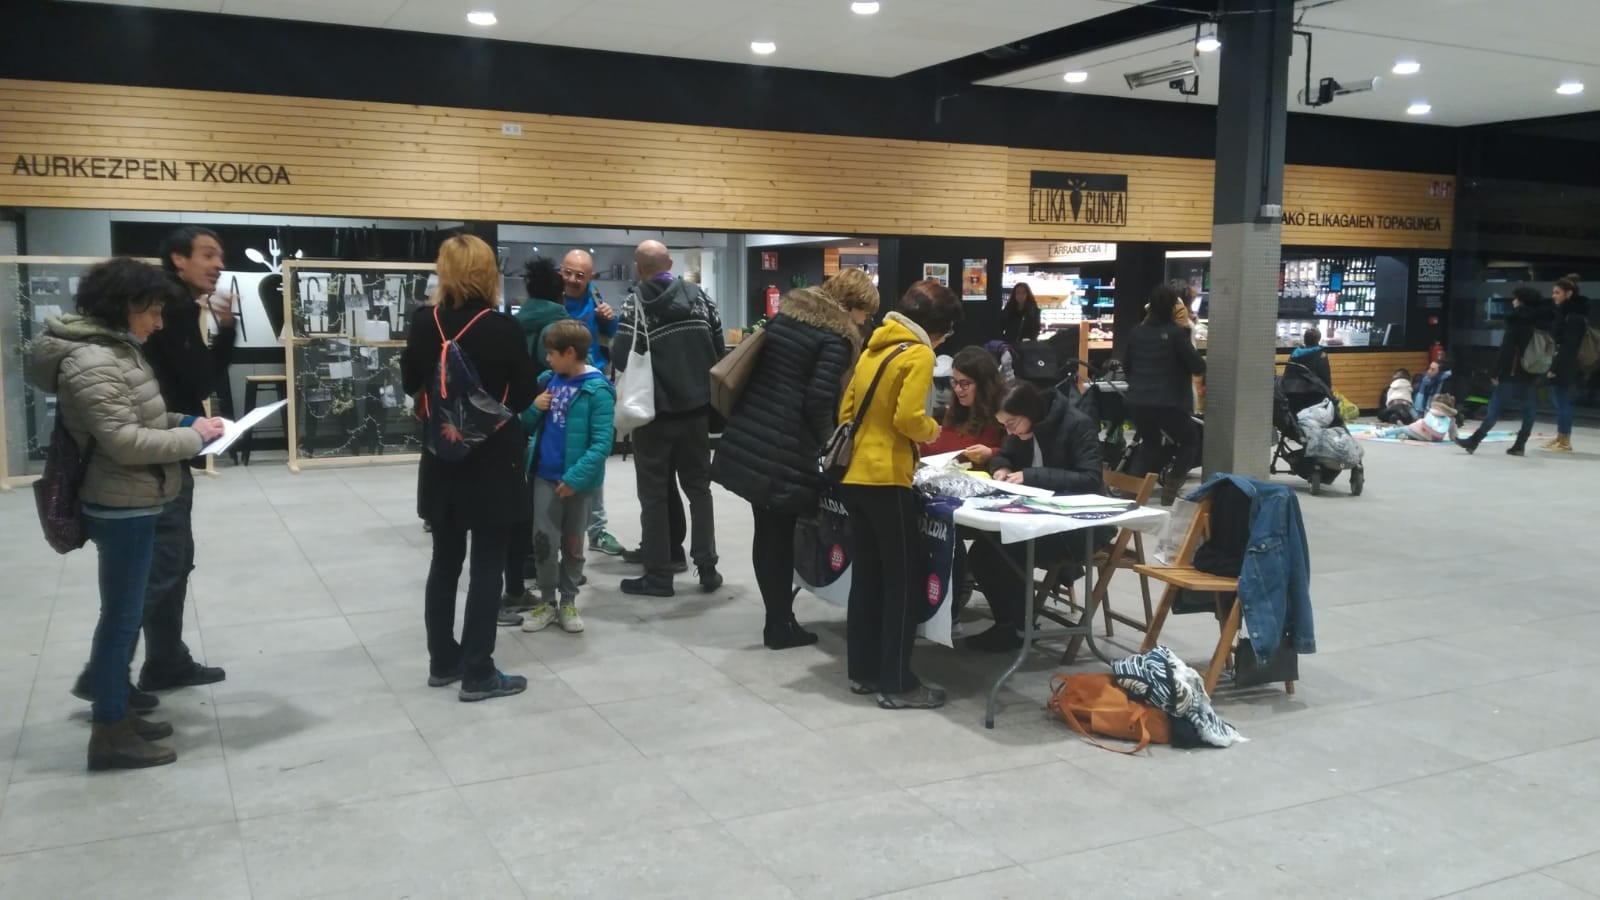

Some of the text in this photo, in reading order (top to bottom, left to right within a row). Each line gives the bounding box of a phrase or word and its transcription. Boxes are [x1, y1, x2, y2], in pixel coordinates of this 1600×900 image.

[12, 154, 291, 185] AURKEZPEN TXOKOA
[1031, 189, 1124, 224] ELIKA GUNEA
[1281, 212, 1441, 231] AKO ELIKAGAIEN TOPAGUNEA
